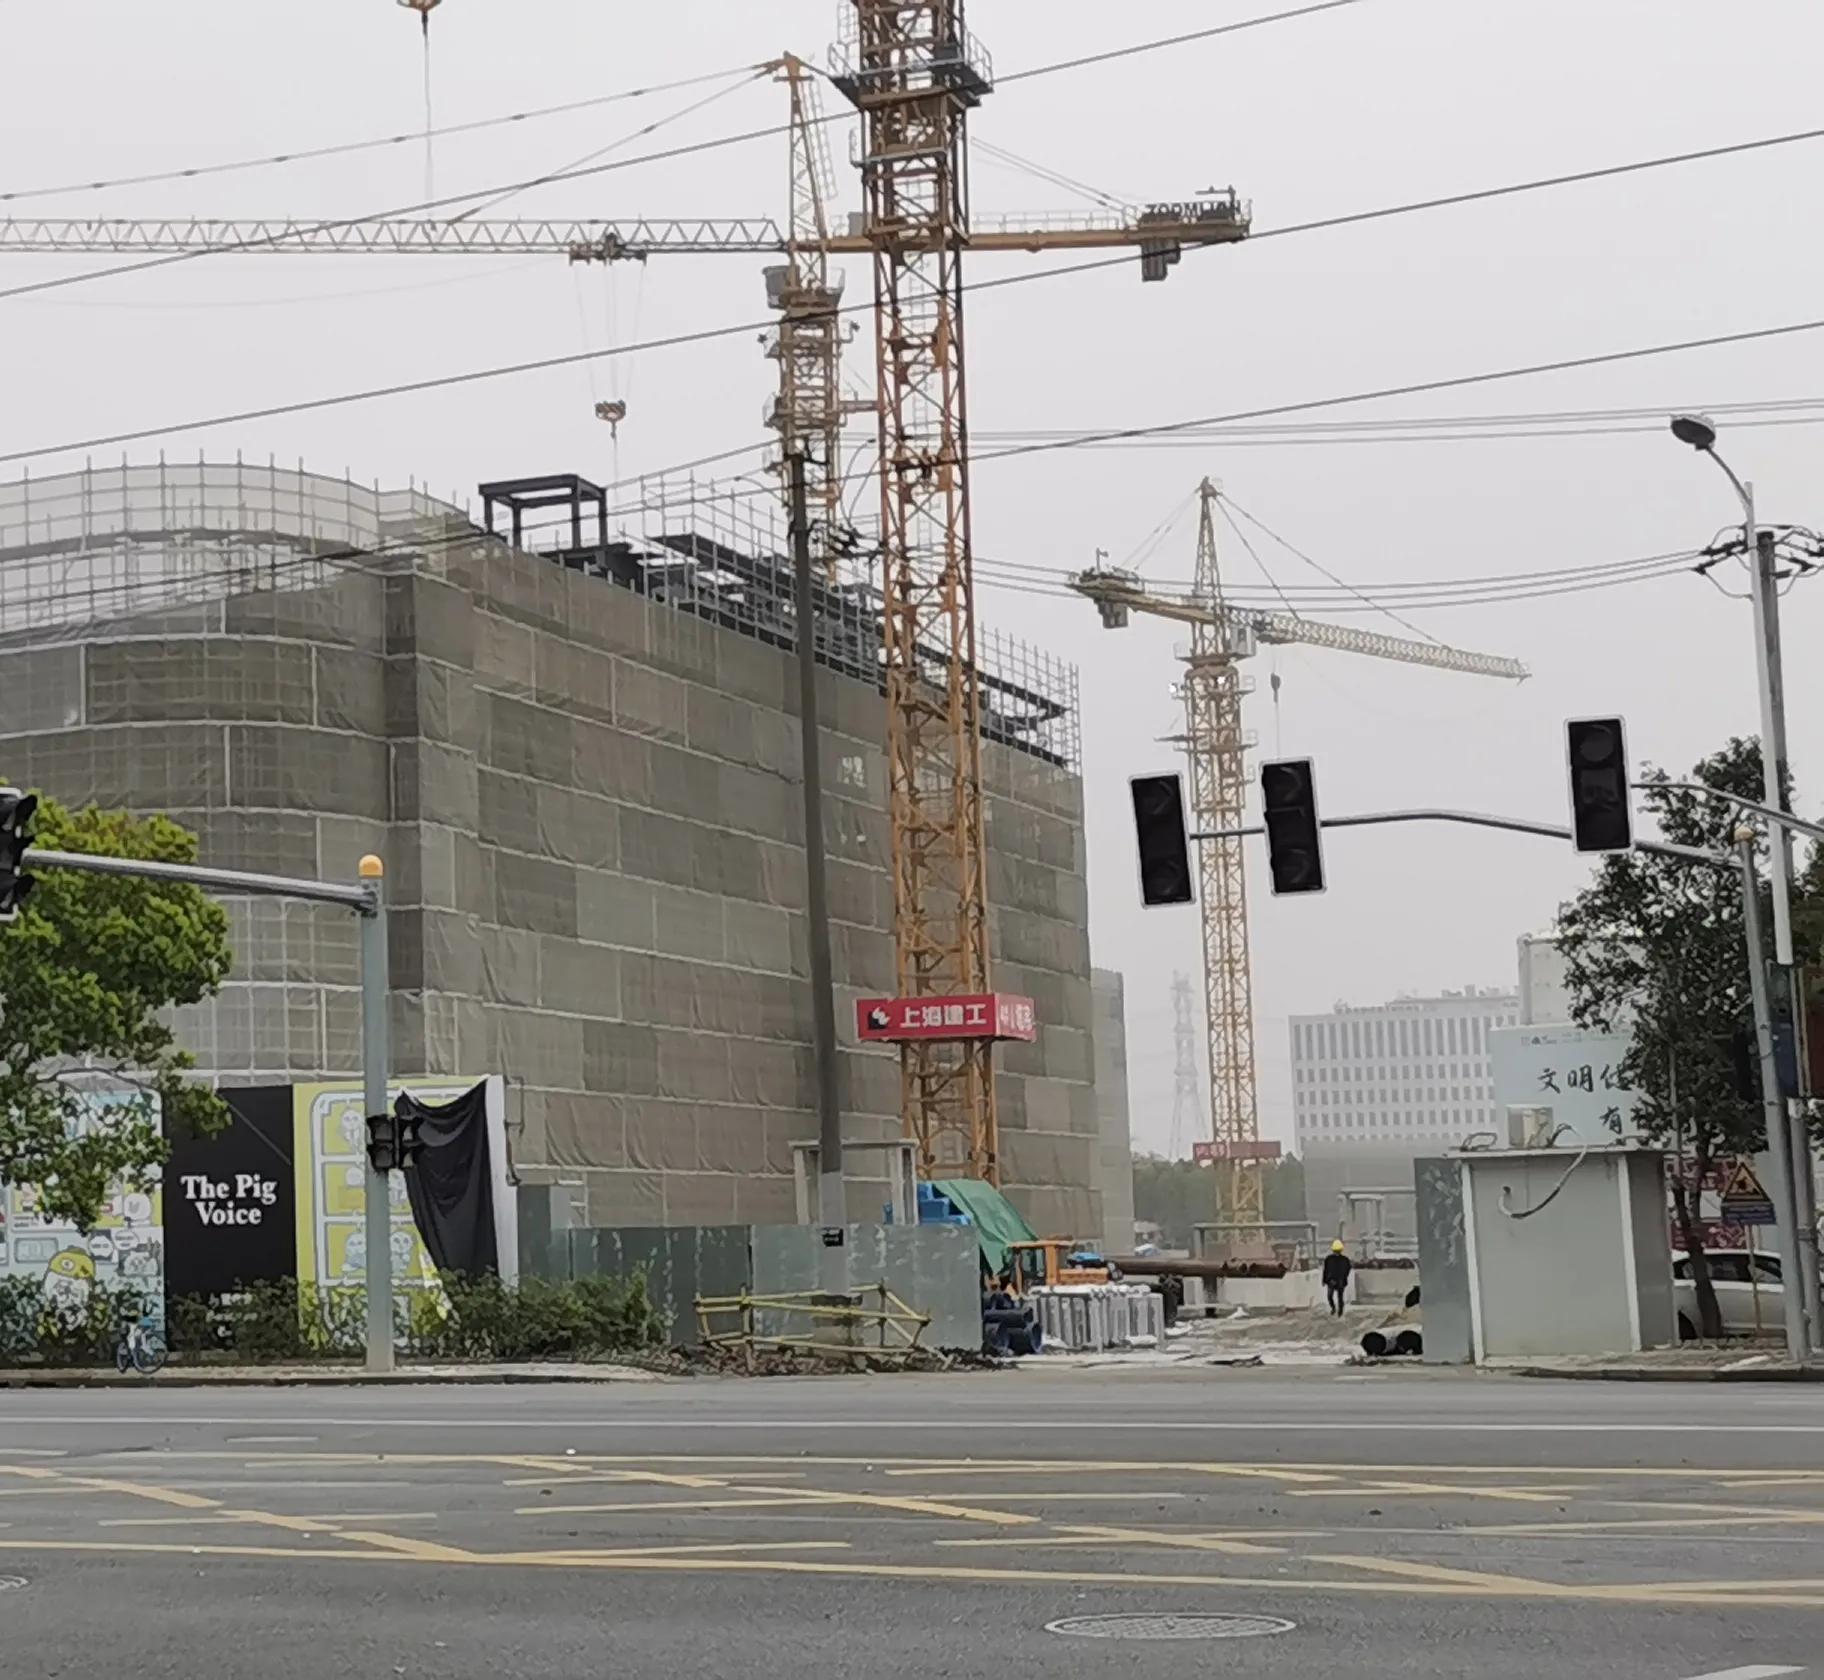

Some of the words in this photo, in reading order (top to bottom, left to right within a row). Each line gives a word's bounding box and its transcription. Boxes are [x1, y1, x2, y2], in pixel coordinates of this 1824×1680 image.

[900, 1003, 987, 1028] 上海建工
[180, 1174, 230, 1200] The
[235, 1173, 277, 1205] Pig
[194, 1200, 262, 1226] Voice
